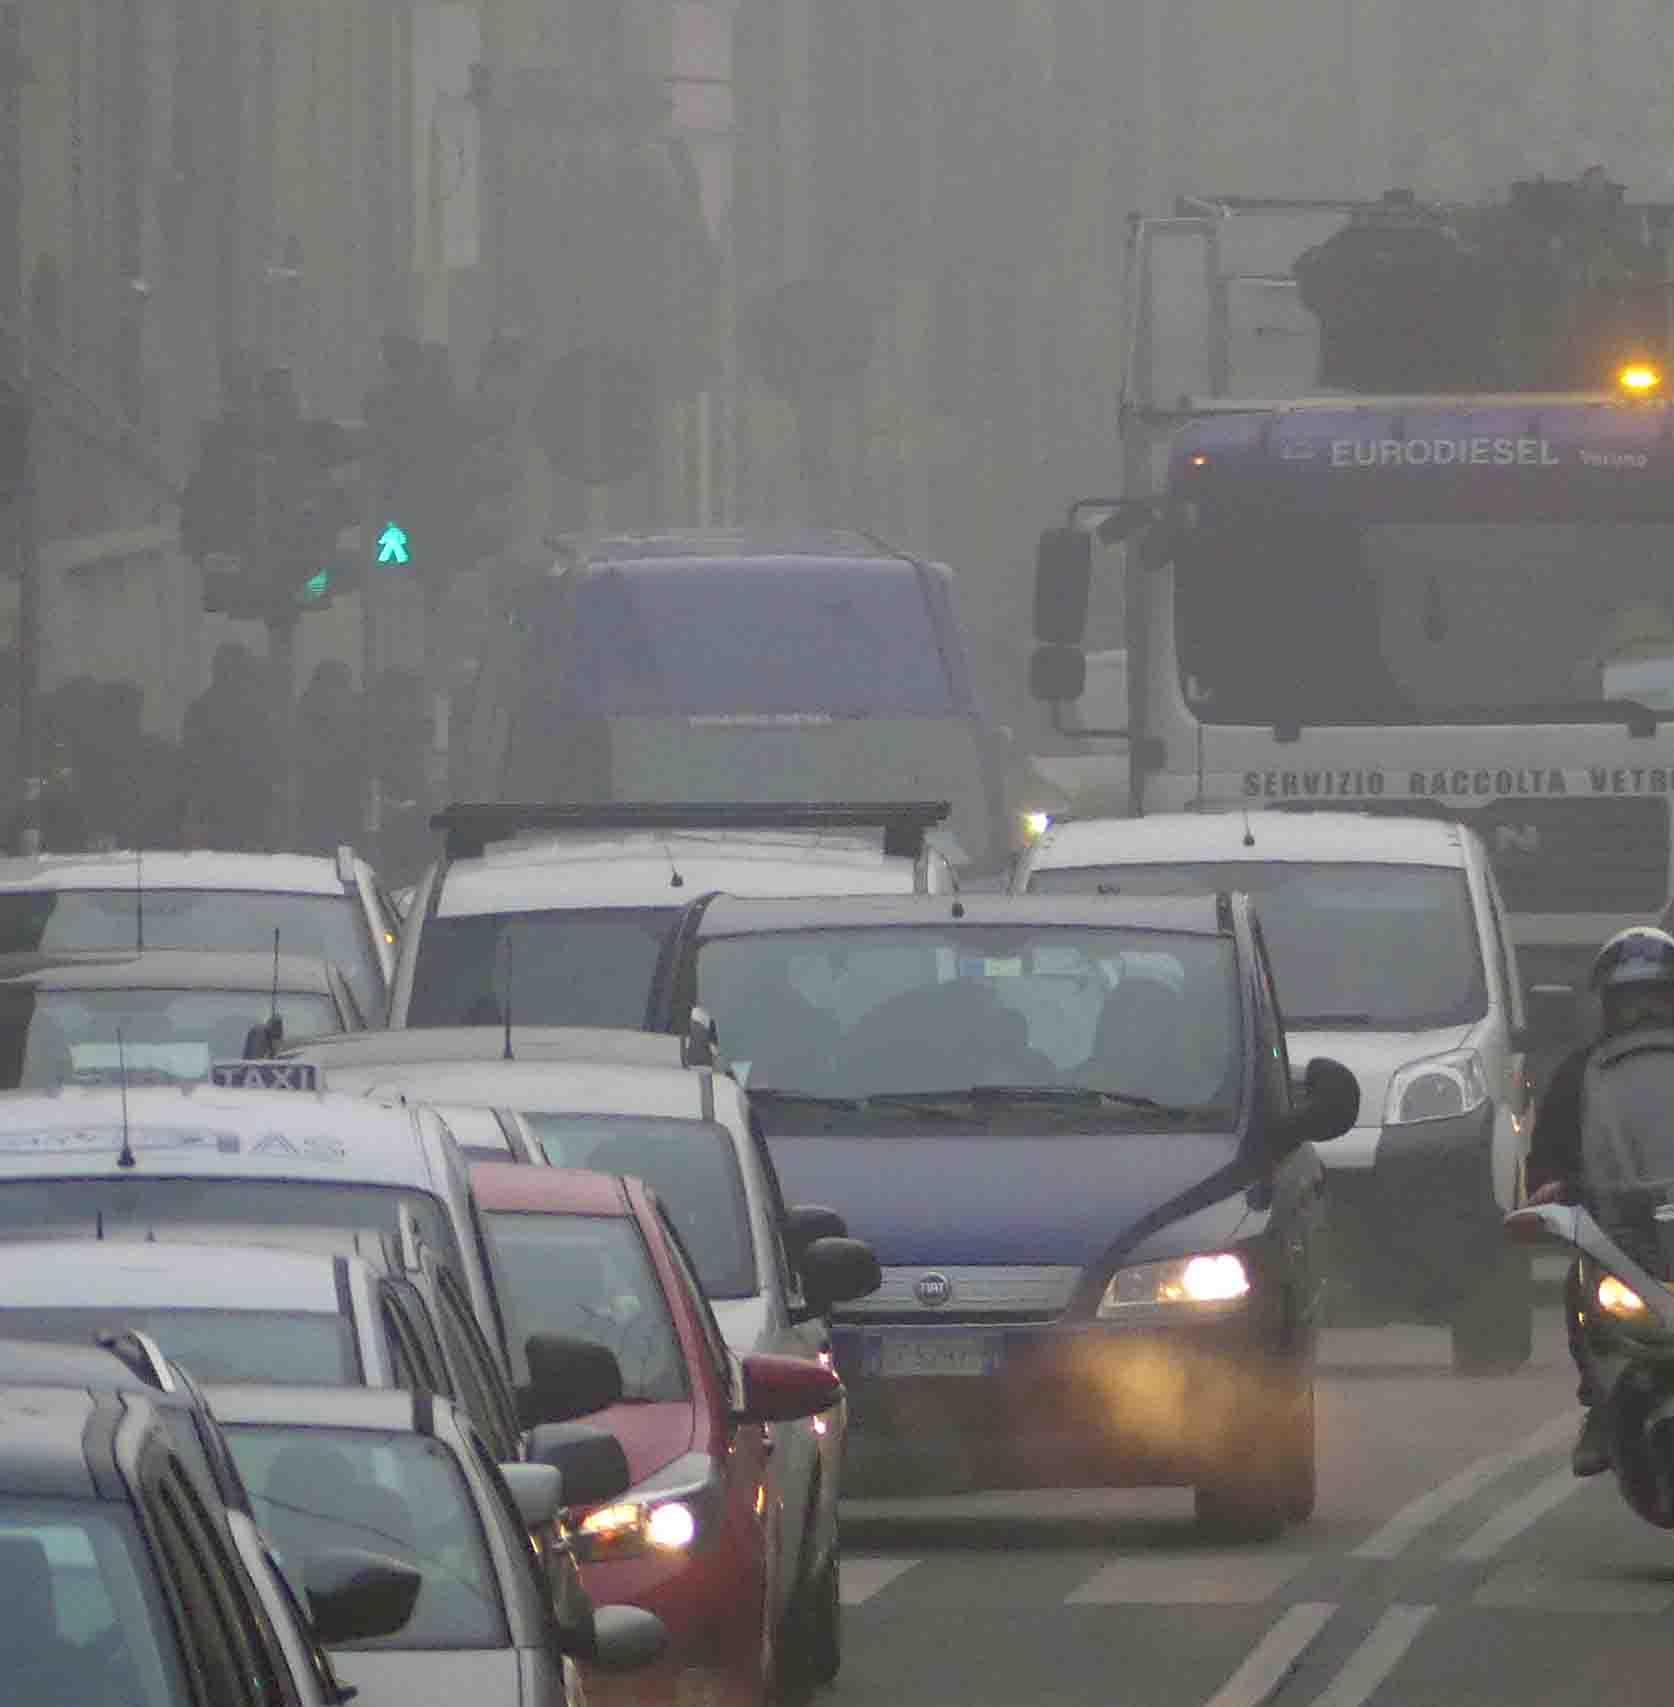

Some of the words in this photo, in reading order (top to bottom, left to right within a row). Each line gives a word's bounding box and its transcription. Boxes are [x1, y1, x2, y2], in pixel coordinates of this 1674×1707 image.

[1329, 438, 1559, 468] EURODIESEL
[1242, 767, 1384, 797] SERVIZIO
[1408, 767, 1567, 796] RACCOLTA
[214, 1065, 312, 1090] TAXI
